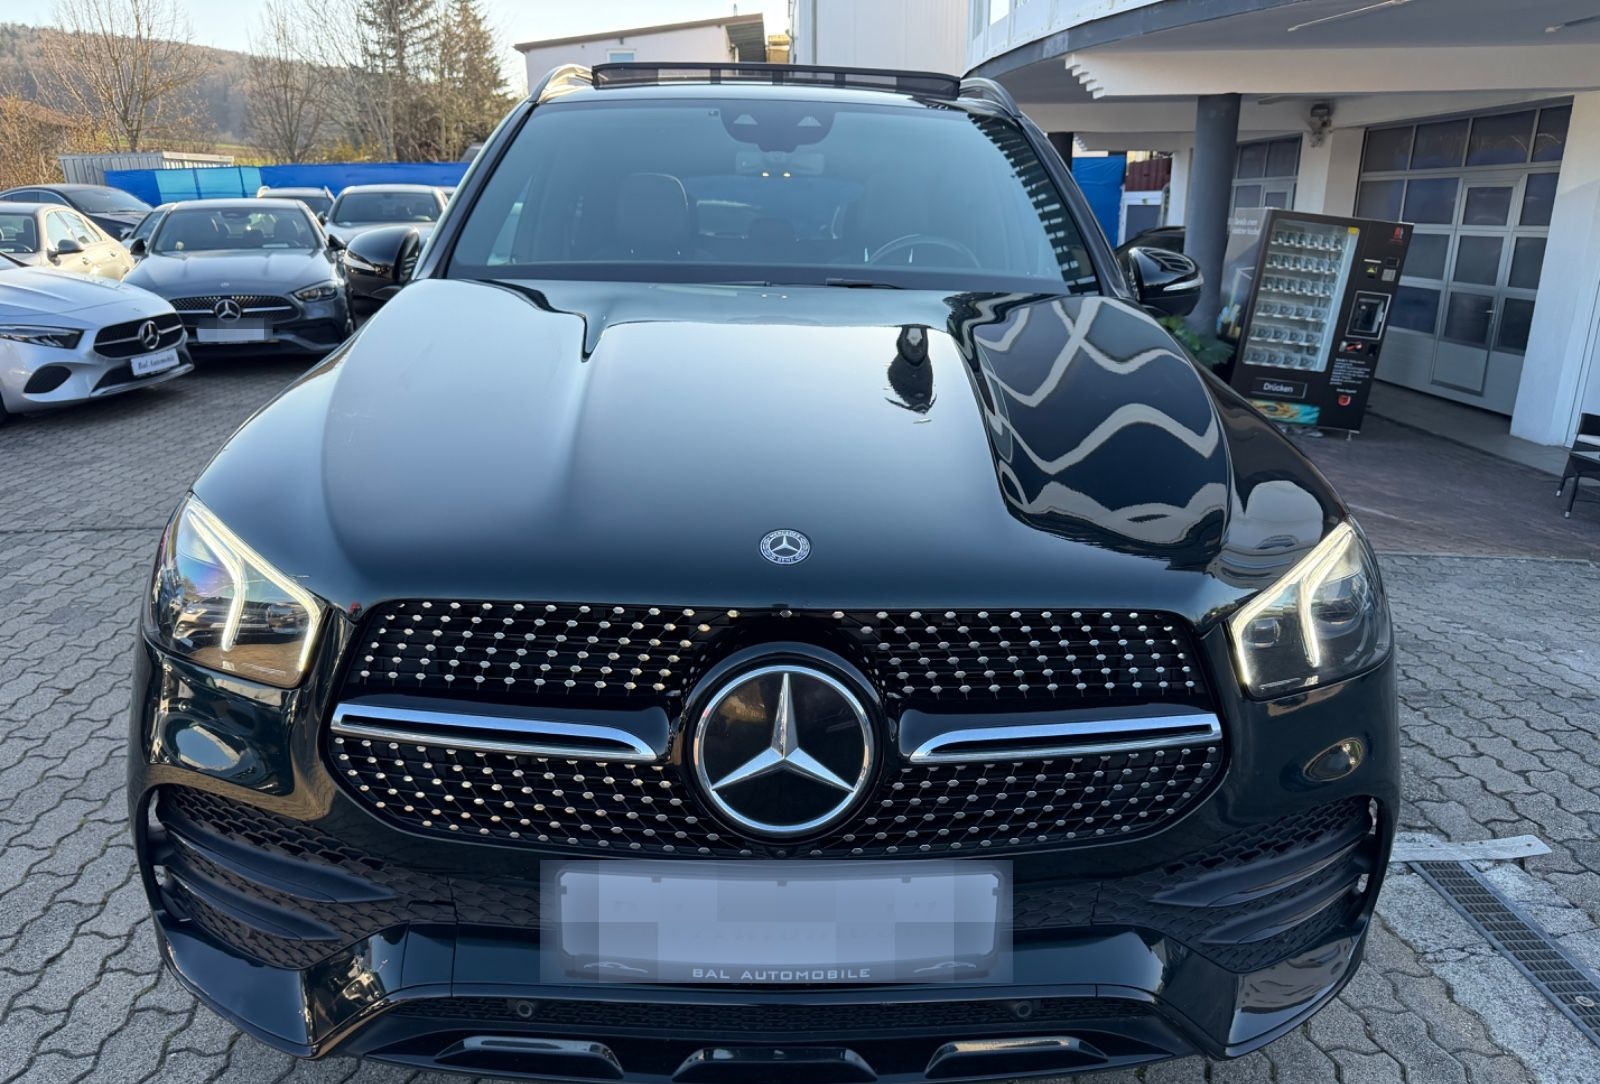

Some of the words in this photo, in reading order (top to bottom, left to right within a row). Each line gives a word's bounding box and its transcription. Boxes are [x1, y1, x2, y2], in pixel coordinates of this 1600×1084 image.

[1263, 382, 1294, 393] Drücken
[692, 968, 730, 979] BAL
[740, 968, 871, 981] AUTOMOBILE
